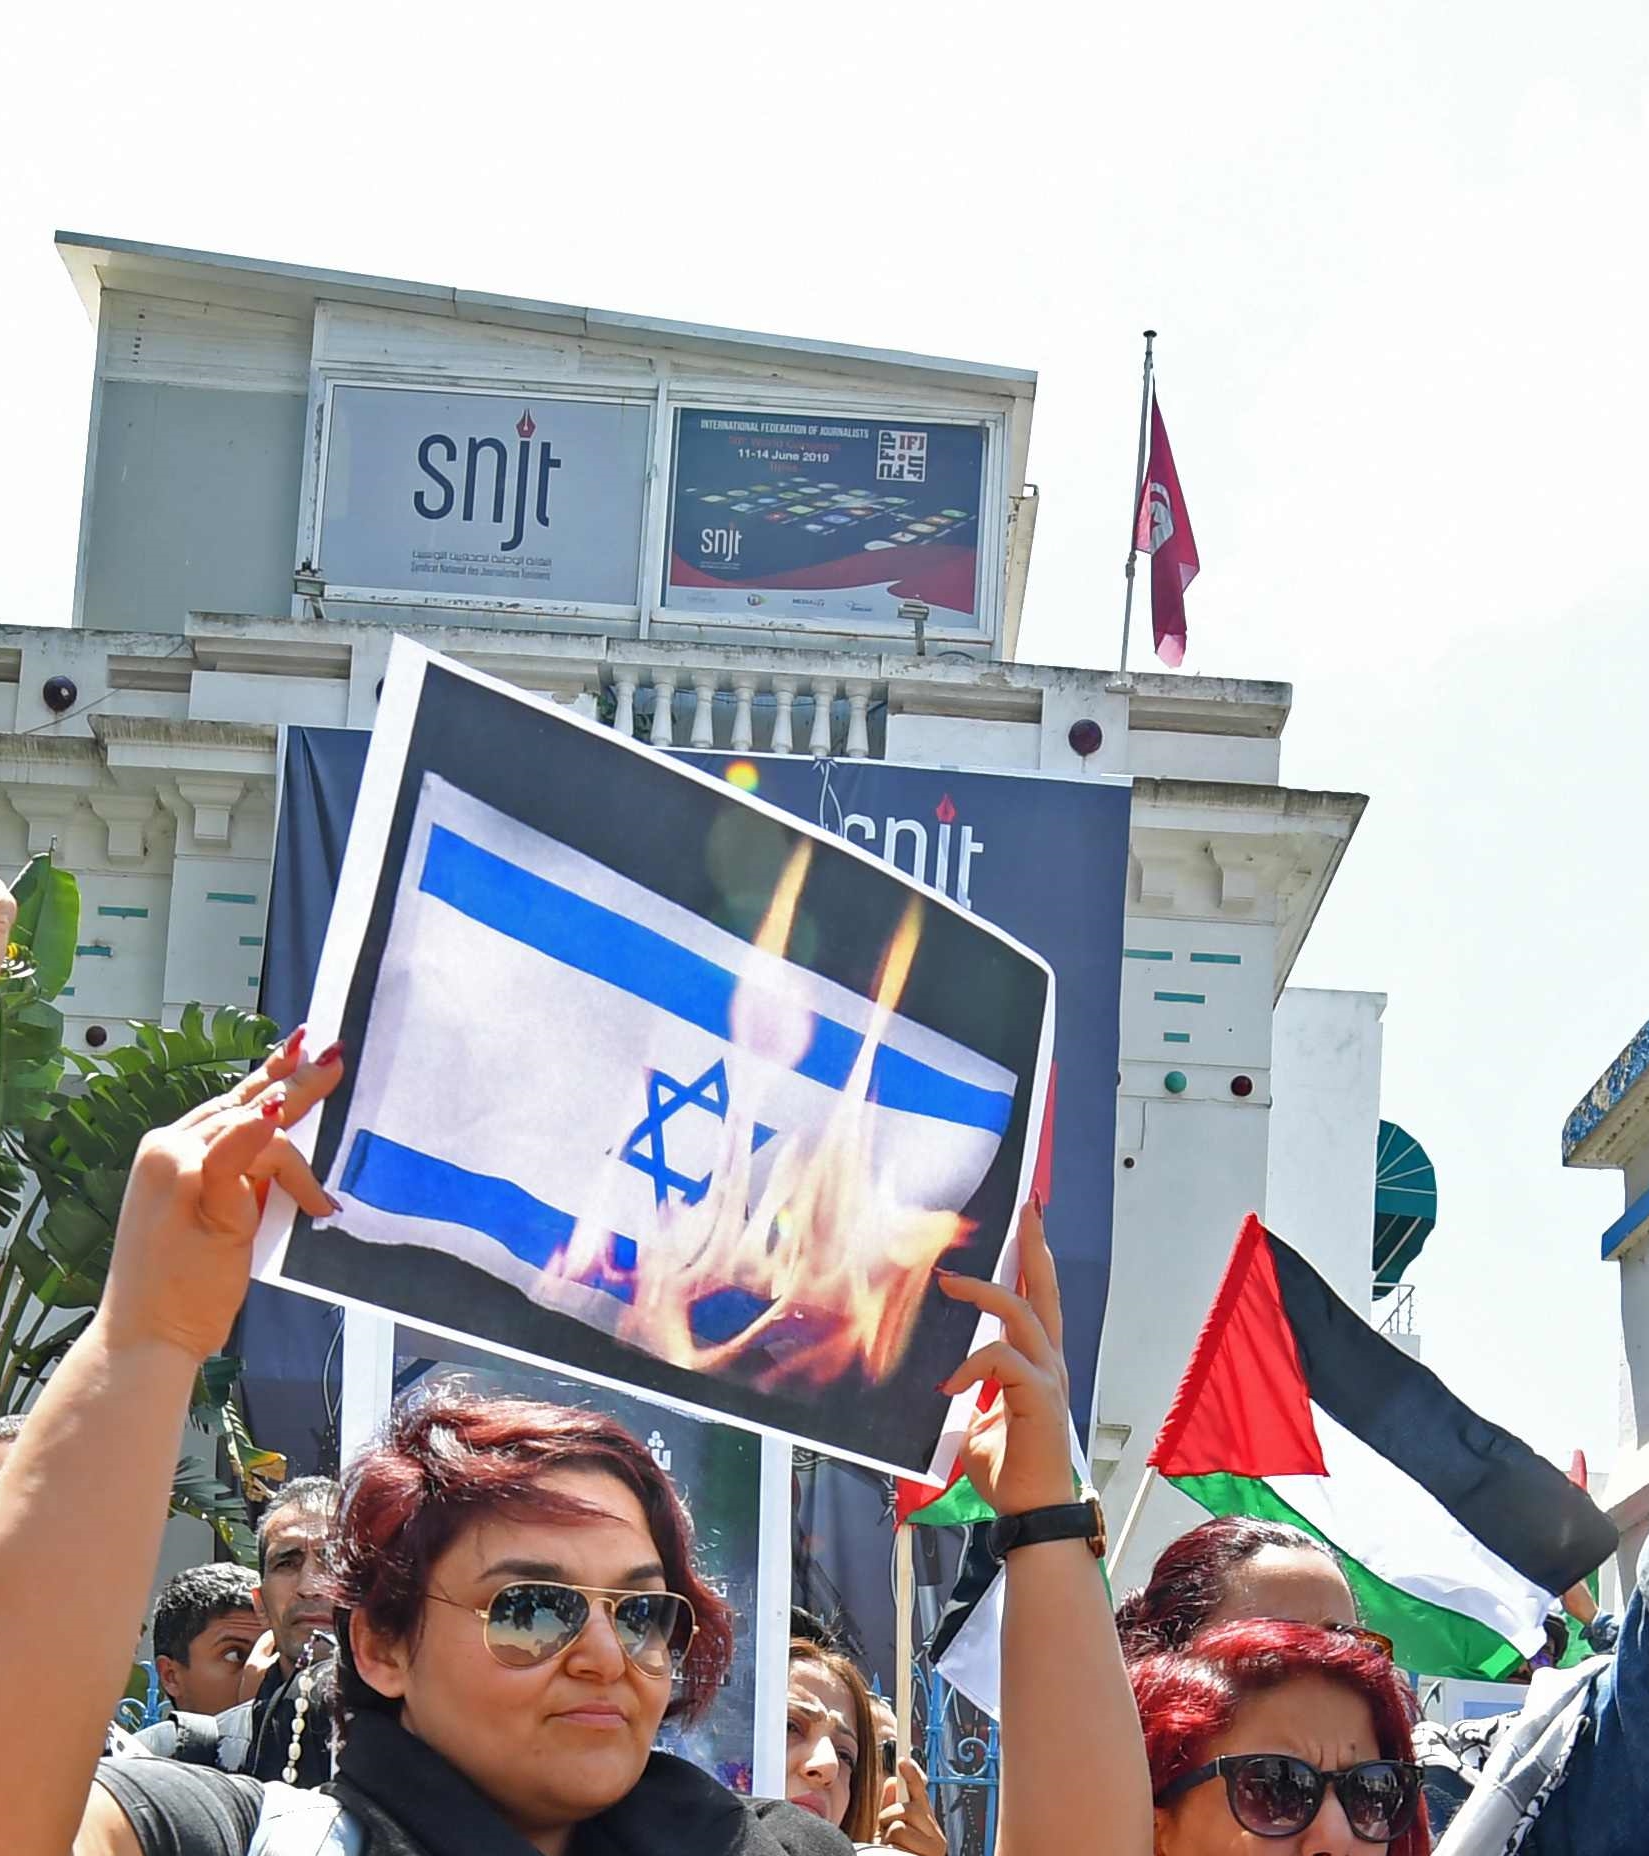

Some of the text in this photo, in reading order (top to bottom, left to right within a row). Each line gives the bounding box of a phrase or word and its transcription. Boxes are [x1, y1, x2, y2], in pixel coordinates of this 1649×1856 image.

[700, 419, 759, 433] INTERNATIONAL
[761, 421, 807, 435] FEDERATION
[738, 448, 829, 463] 11-14 June 2019
[414, 408, 562, 551] snjt
[701, 523, 743, 562] snjt
[843, 794, 985, 910] njt
